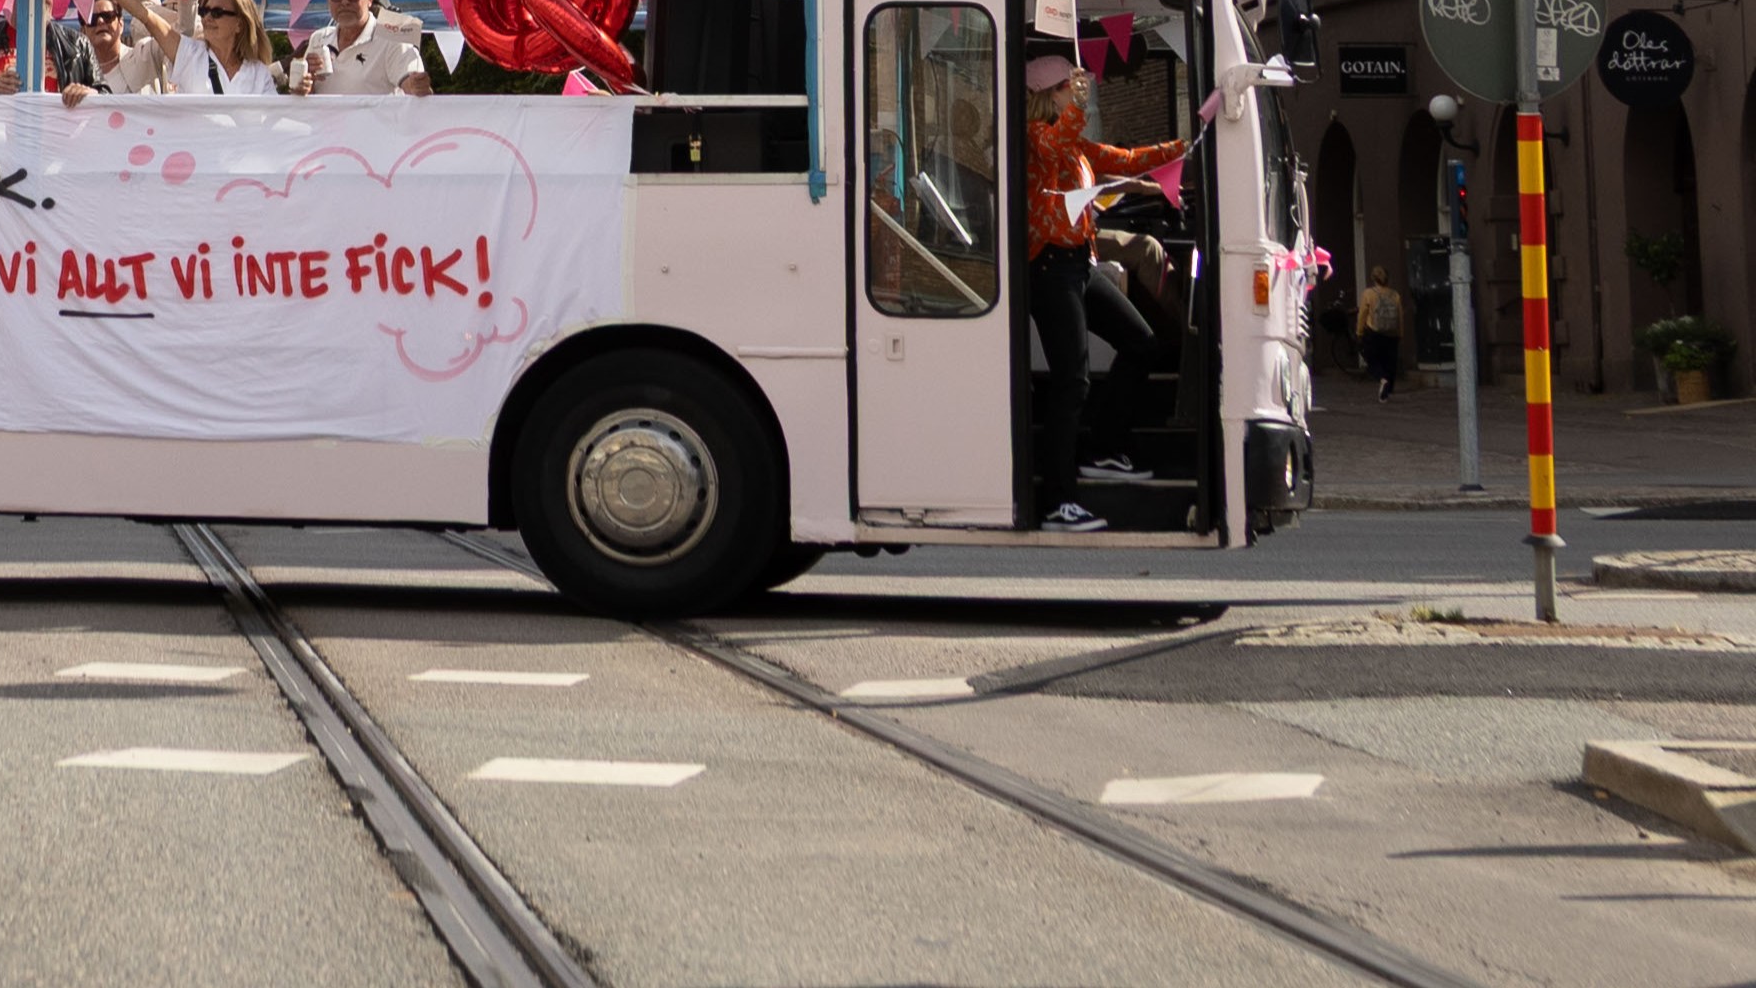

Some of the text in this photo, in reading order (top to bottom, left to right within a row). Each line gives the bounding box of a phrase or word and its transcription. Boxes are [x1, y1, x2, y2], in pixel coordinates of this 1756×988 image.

[1623, 30, 1668, 52] Oles
[1608, 51, 1686, 72] döttrar
[57, 249, 156, 304] ALLT
